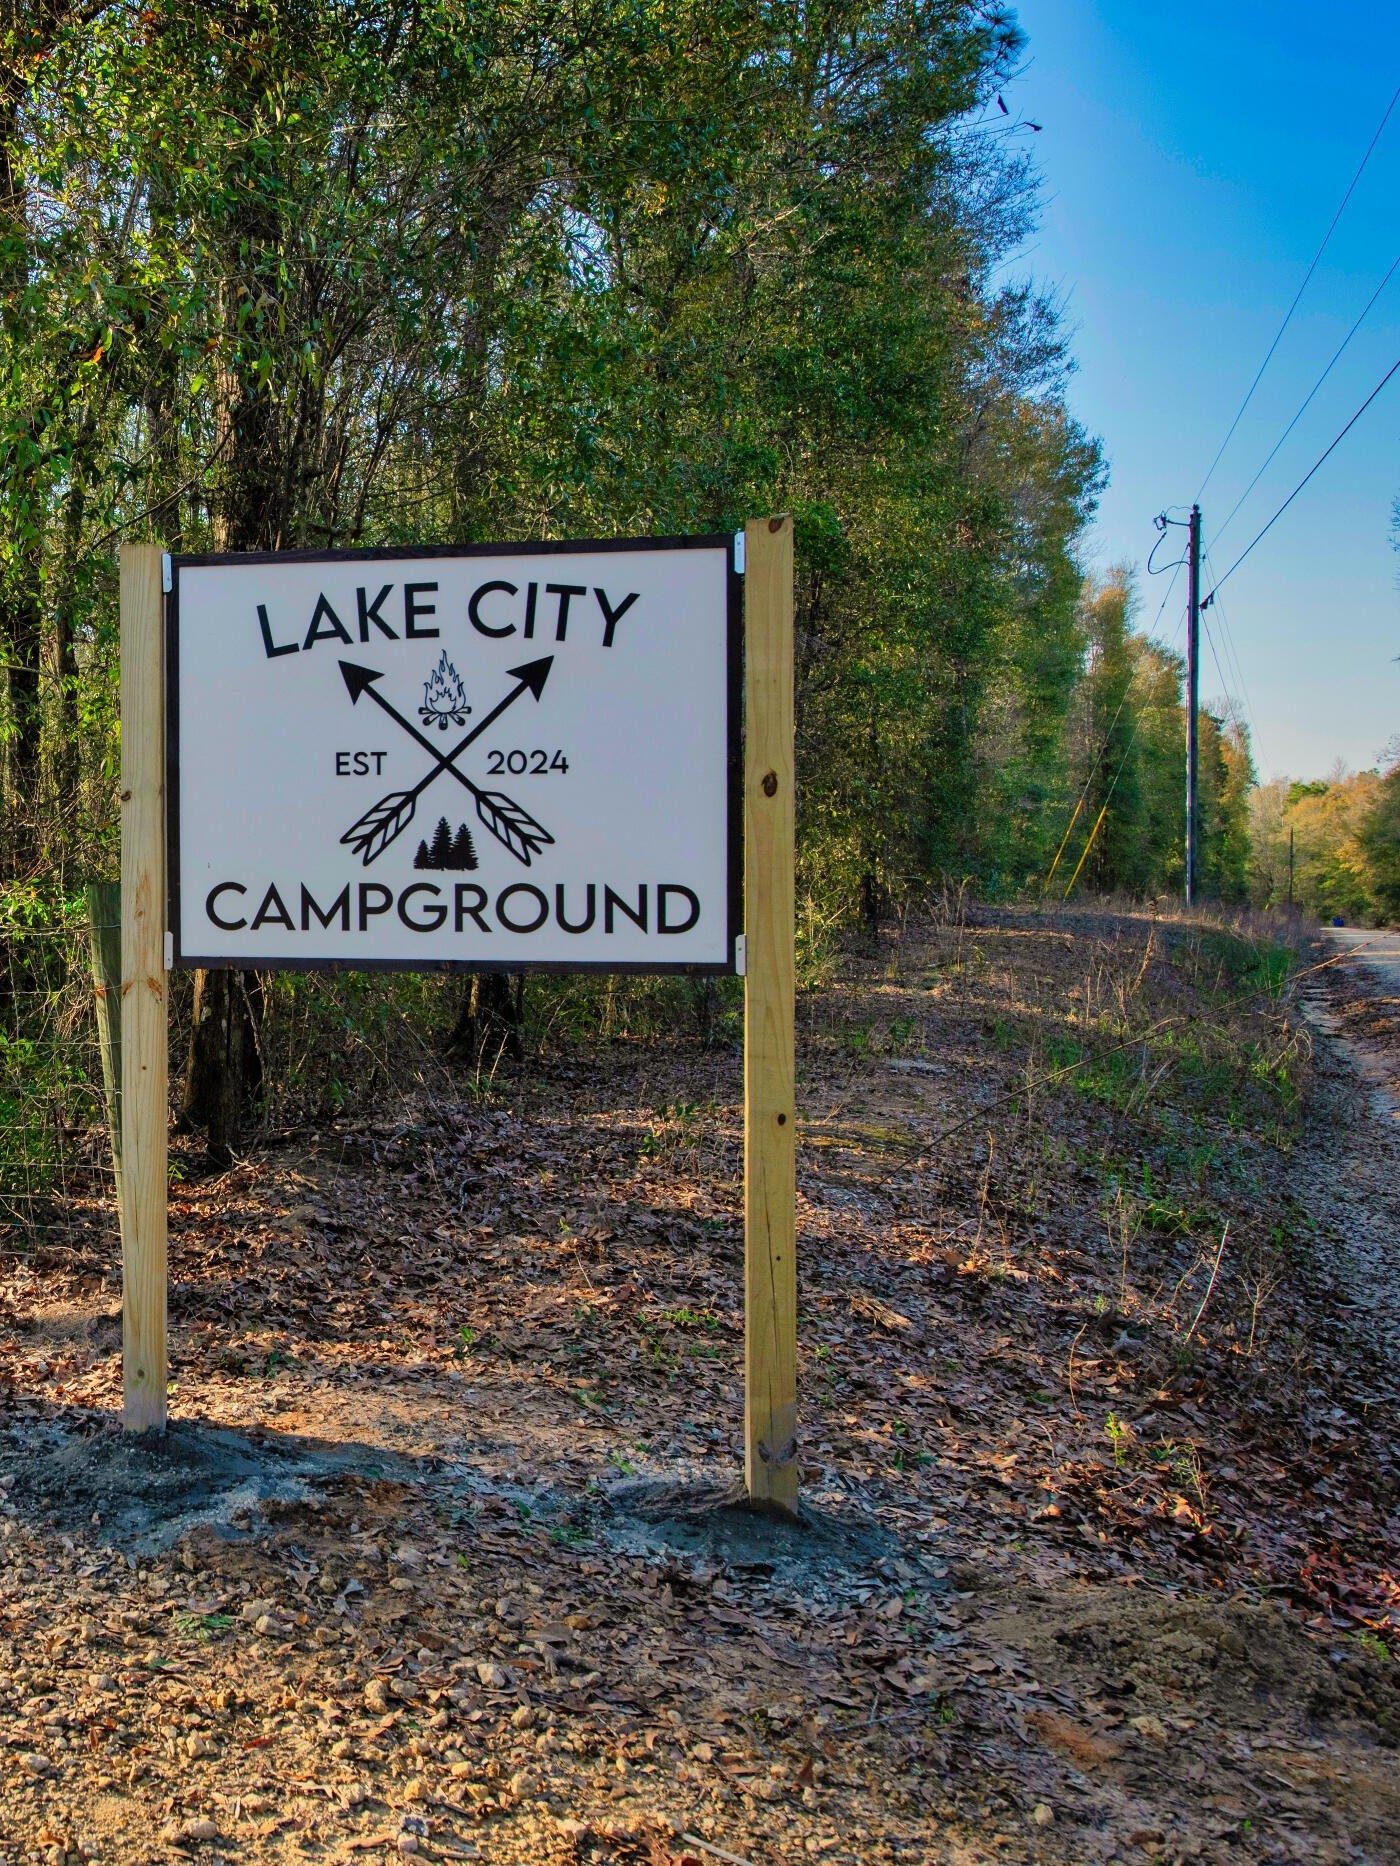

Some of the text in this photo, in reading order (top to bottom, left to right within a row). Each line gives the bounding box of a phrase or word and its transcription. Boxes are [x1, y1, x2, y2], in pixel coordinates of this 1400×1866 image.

[256, 580, 641, 659] LAKE CITY
[335, 749, 570, 777] EST 2024
[205, 881, 701, 935] CAMPGROUND
